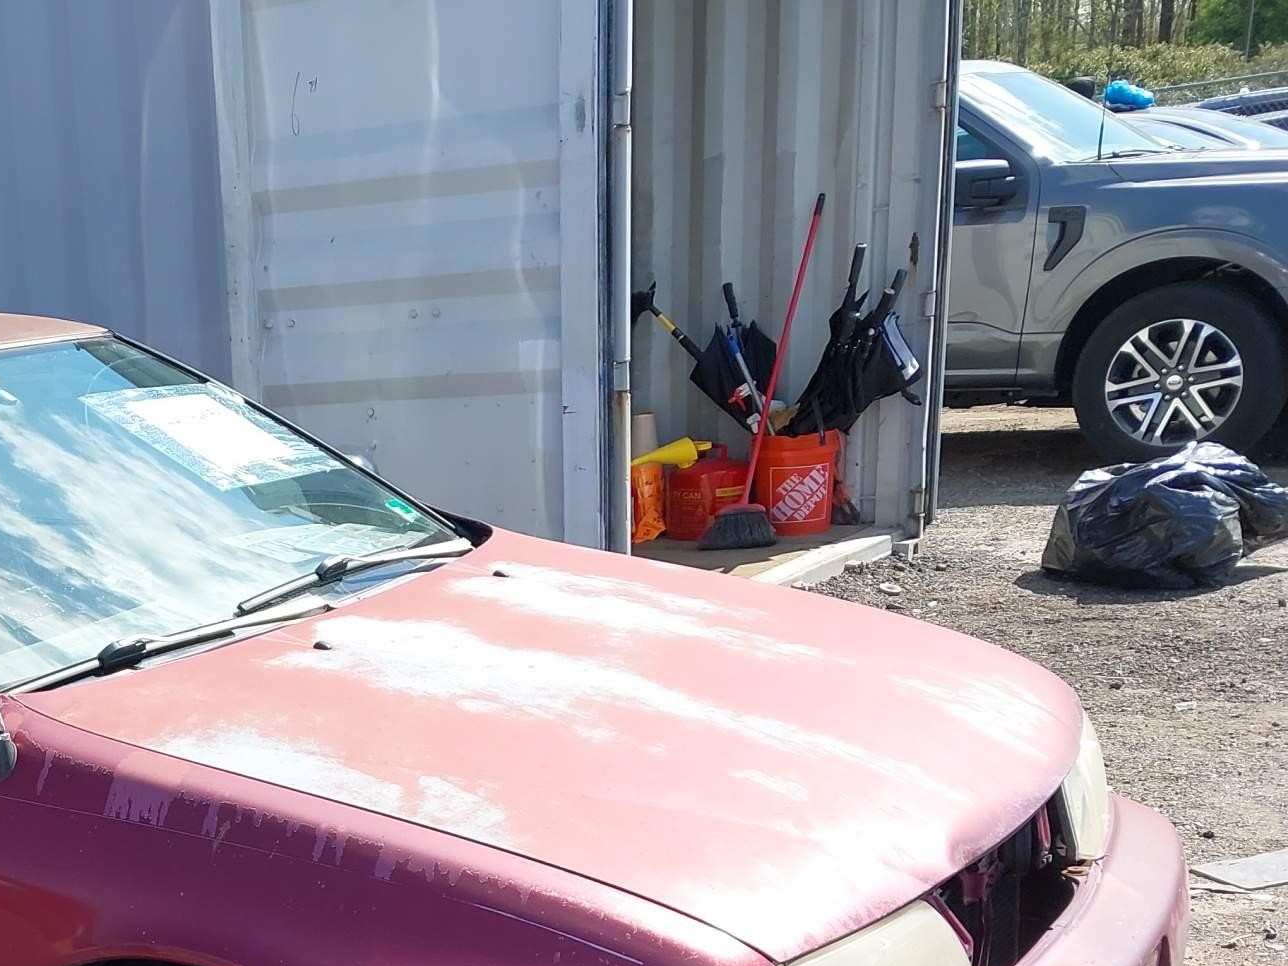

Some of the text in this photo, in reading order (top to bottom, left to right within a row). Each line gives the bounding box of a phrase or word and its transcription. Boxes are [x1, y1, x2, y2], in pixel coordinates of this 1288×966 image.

[773, 464, 828, 521] HOME
[776, 473, 803, 496] THE
[793, 485, 827, 521] DEPOT
